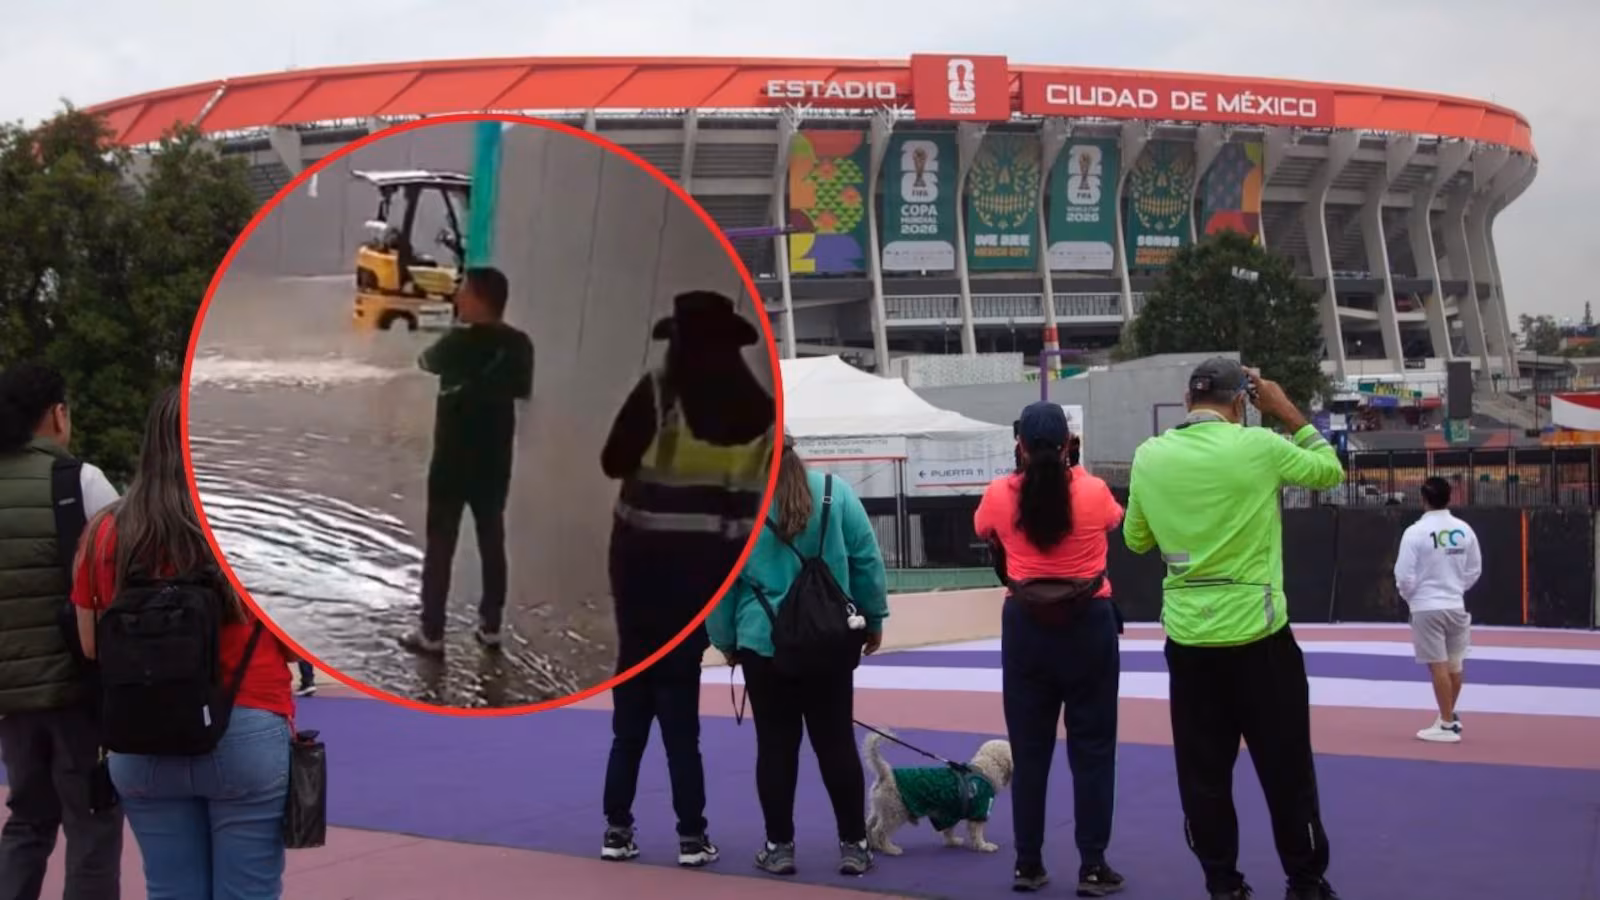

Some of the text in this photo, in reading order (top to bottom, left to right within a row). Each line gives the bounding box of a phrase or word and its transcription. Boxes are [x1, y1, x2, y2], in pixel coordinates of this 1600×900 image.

[767, 80, 896, 99] ESTADIO
[1046, 84, 1316, 117] CIUDAD DE MÉXICO
[911, 189, 928, 197] FIFA
[900, 204, 938, 216] COPA
[1066, 212, 1100, 222] 2026
[900, 224, 938, 235] 2026
[931, 468, 974, 478] PUERTA
[1429, 528, 1465, 549] 100
